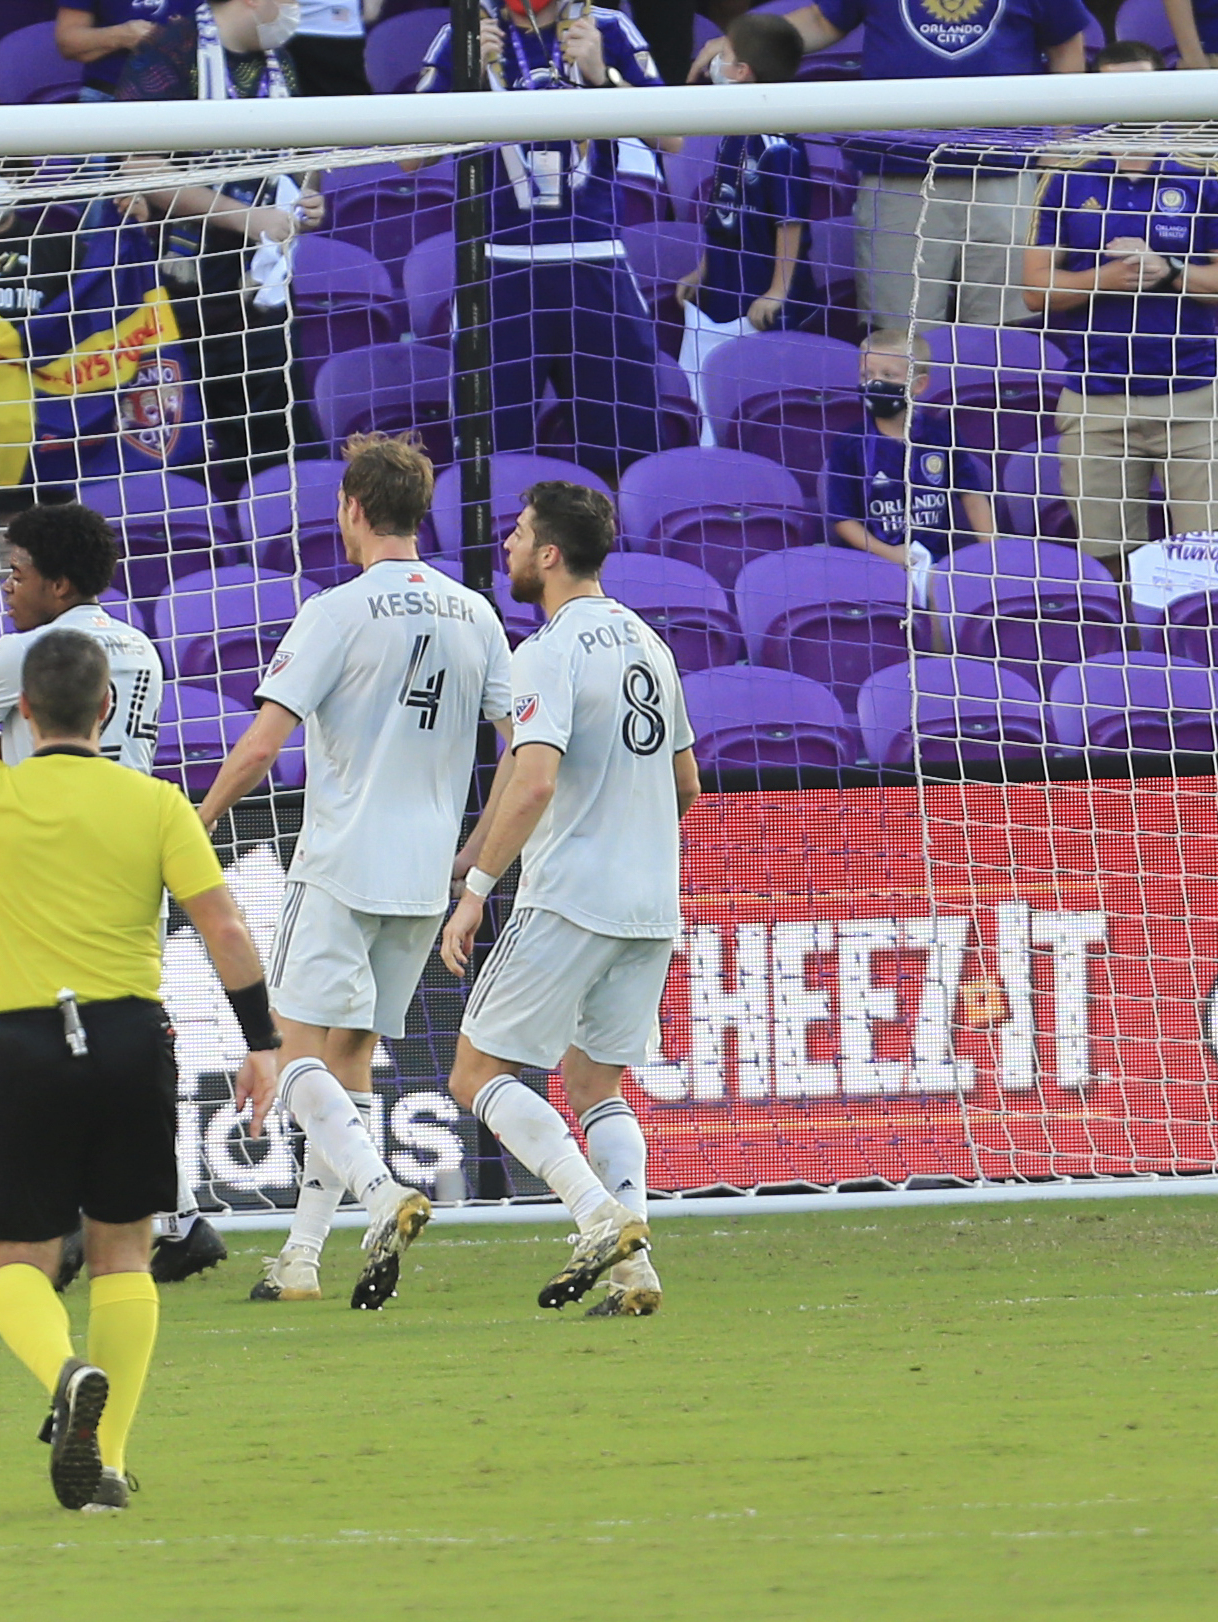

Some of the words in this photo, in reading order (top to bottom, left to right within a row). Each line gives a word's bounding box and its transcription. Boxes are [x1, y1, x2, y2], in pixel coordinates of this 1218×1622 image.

[920, 23, 982, 34] ORLANDO
[937, 33, 966, 43] CITY
[367, 591, 475, 624] KESSLER
[398, 634, 446, 730] 4
[623, 660, 665, 757] 8
